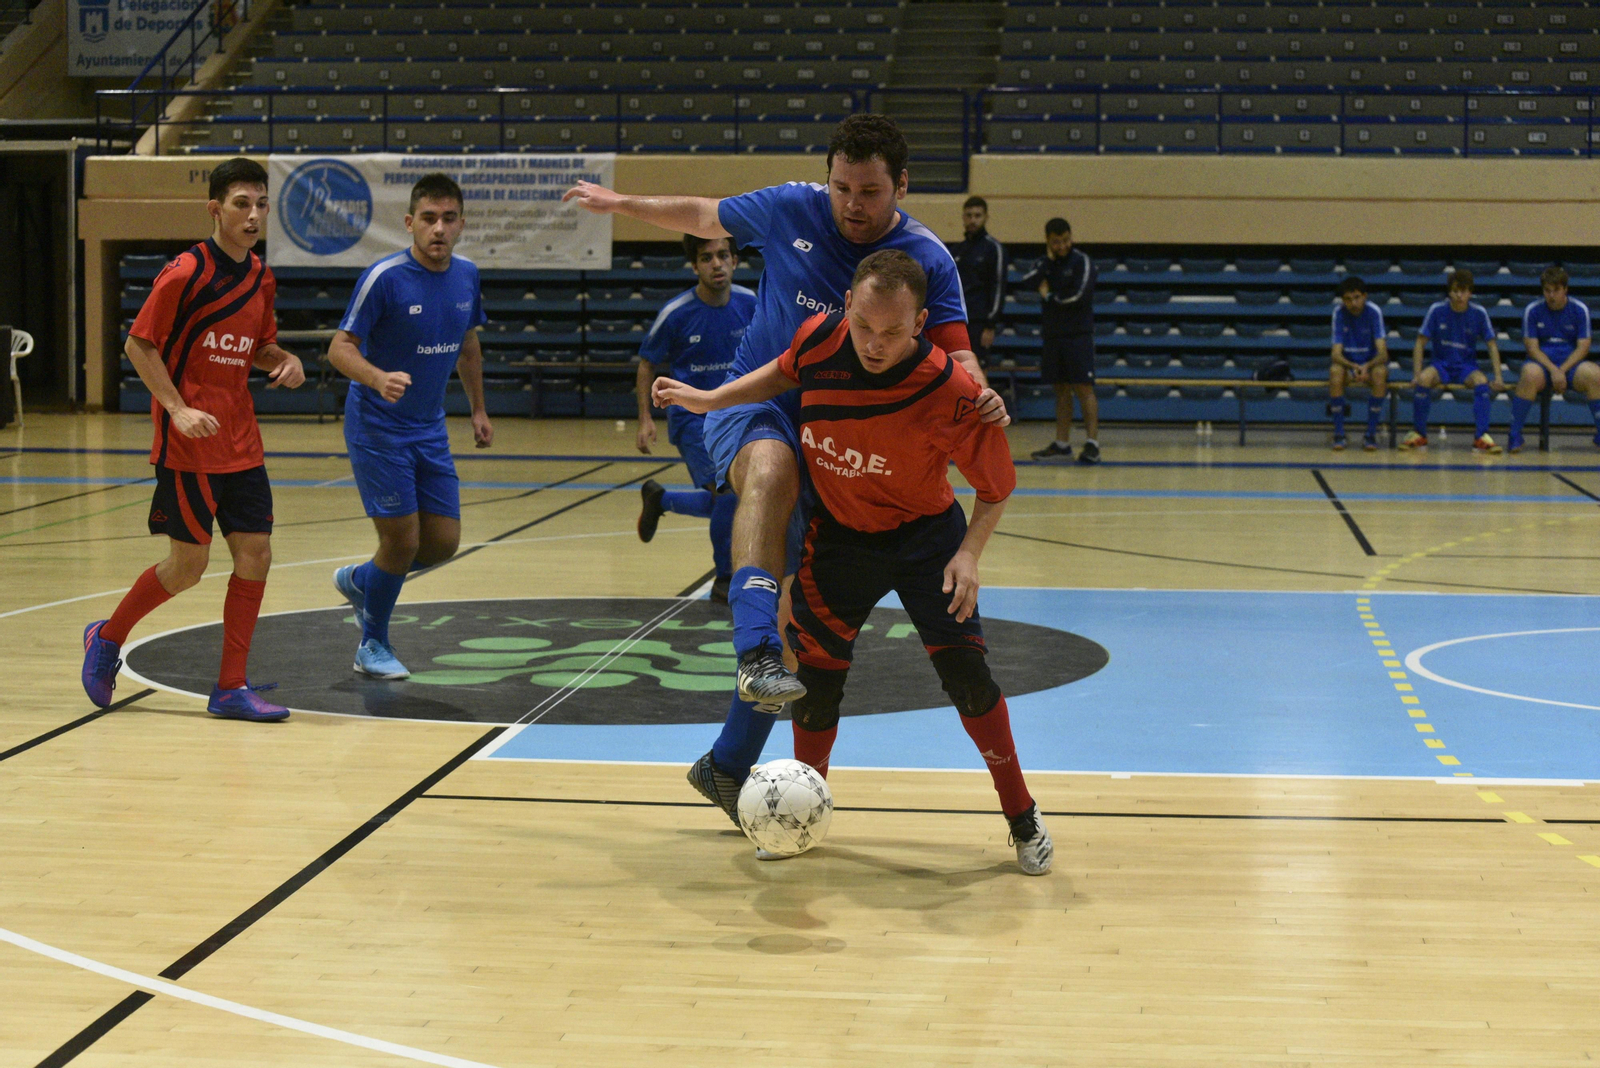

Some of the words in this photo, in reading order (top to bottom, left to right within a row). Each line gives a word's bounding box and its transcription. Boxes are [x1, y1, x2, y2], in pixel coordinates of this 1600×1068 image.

[114, 16, 132, 31] de
[465, 158, 477, 168] DE
[480, 158, 518, 169] PADRES
[529, 158, 570, 169] MADRES
[572, 158, 585, 169] DE
